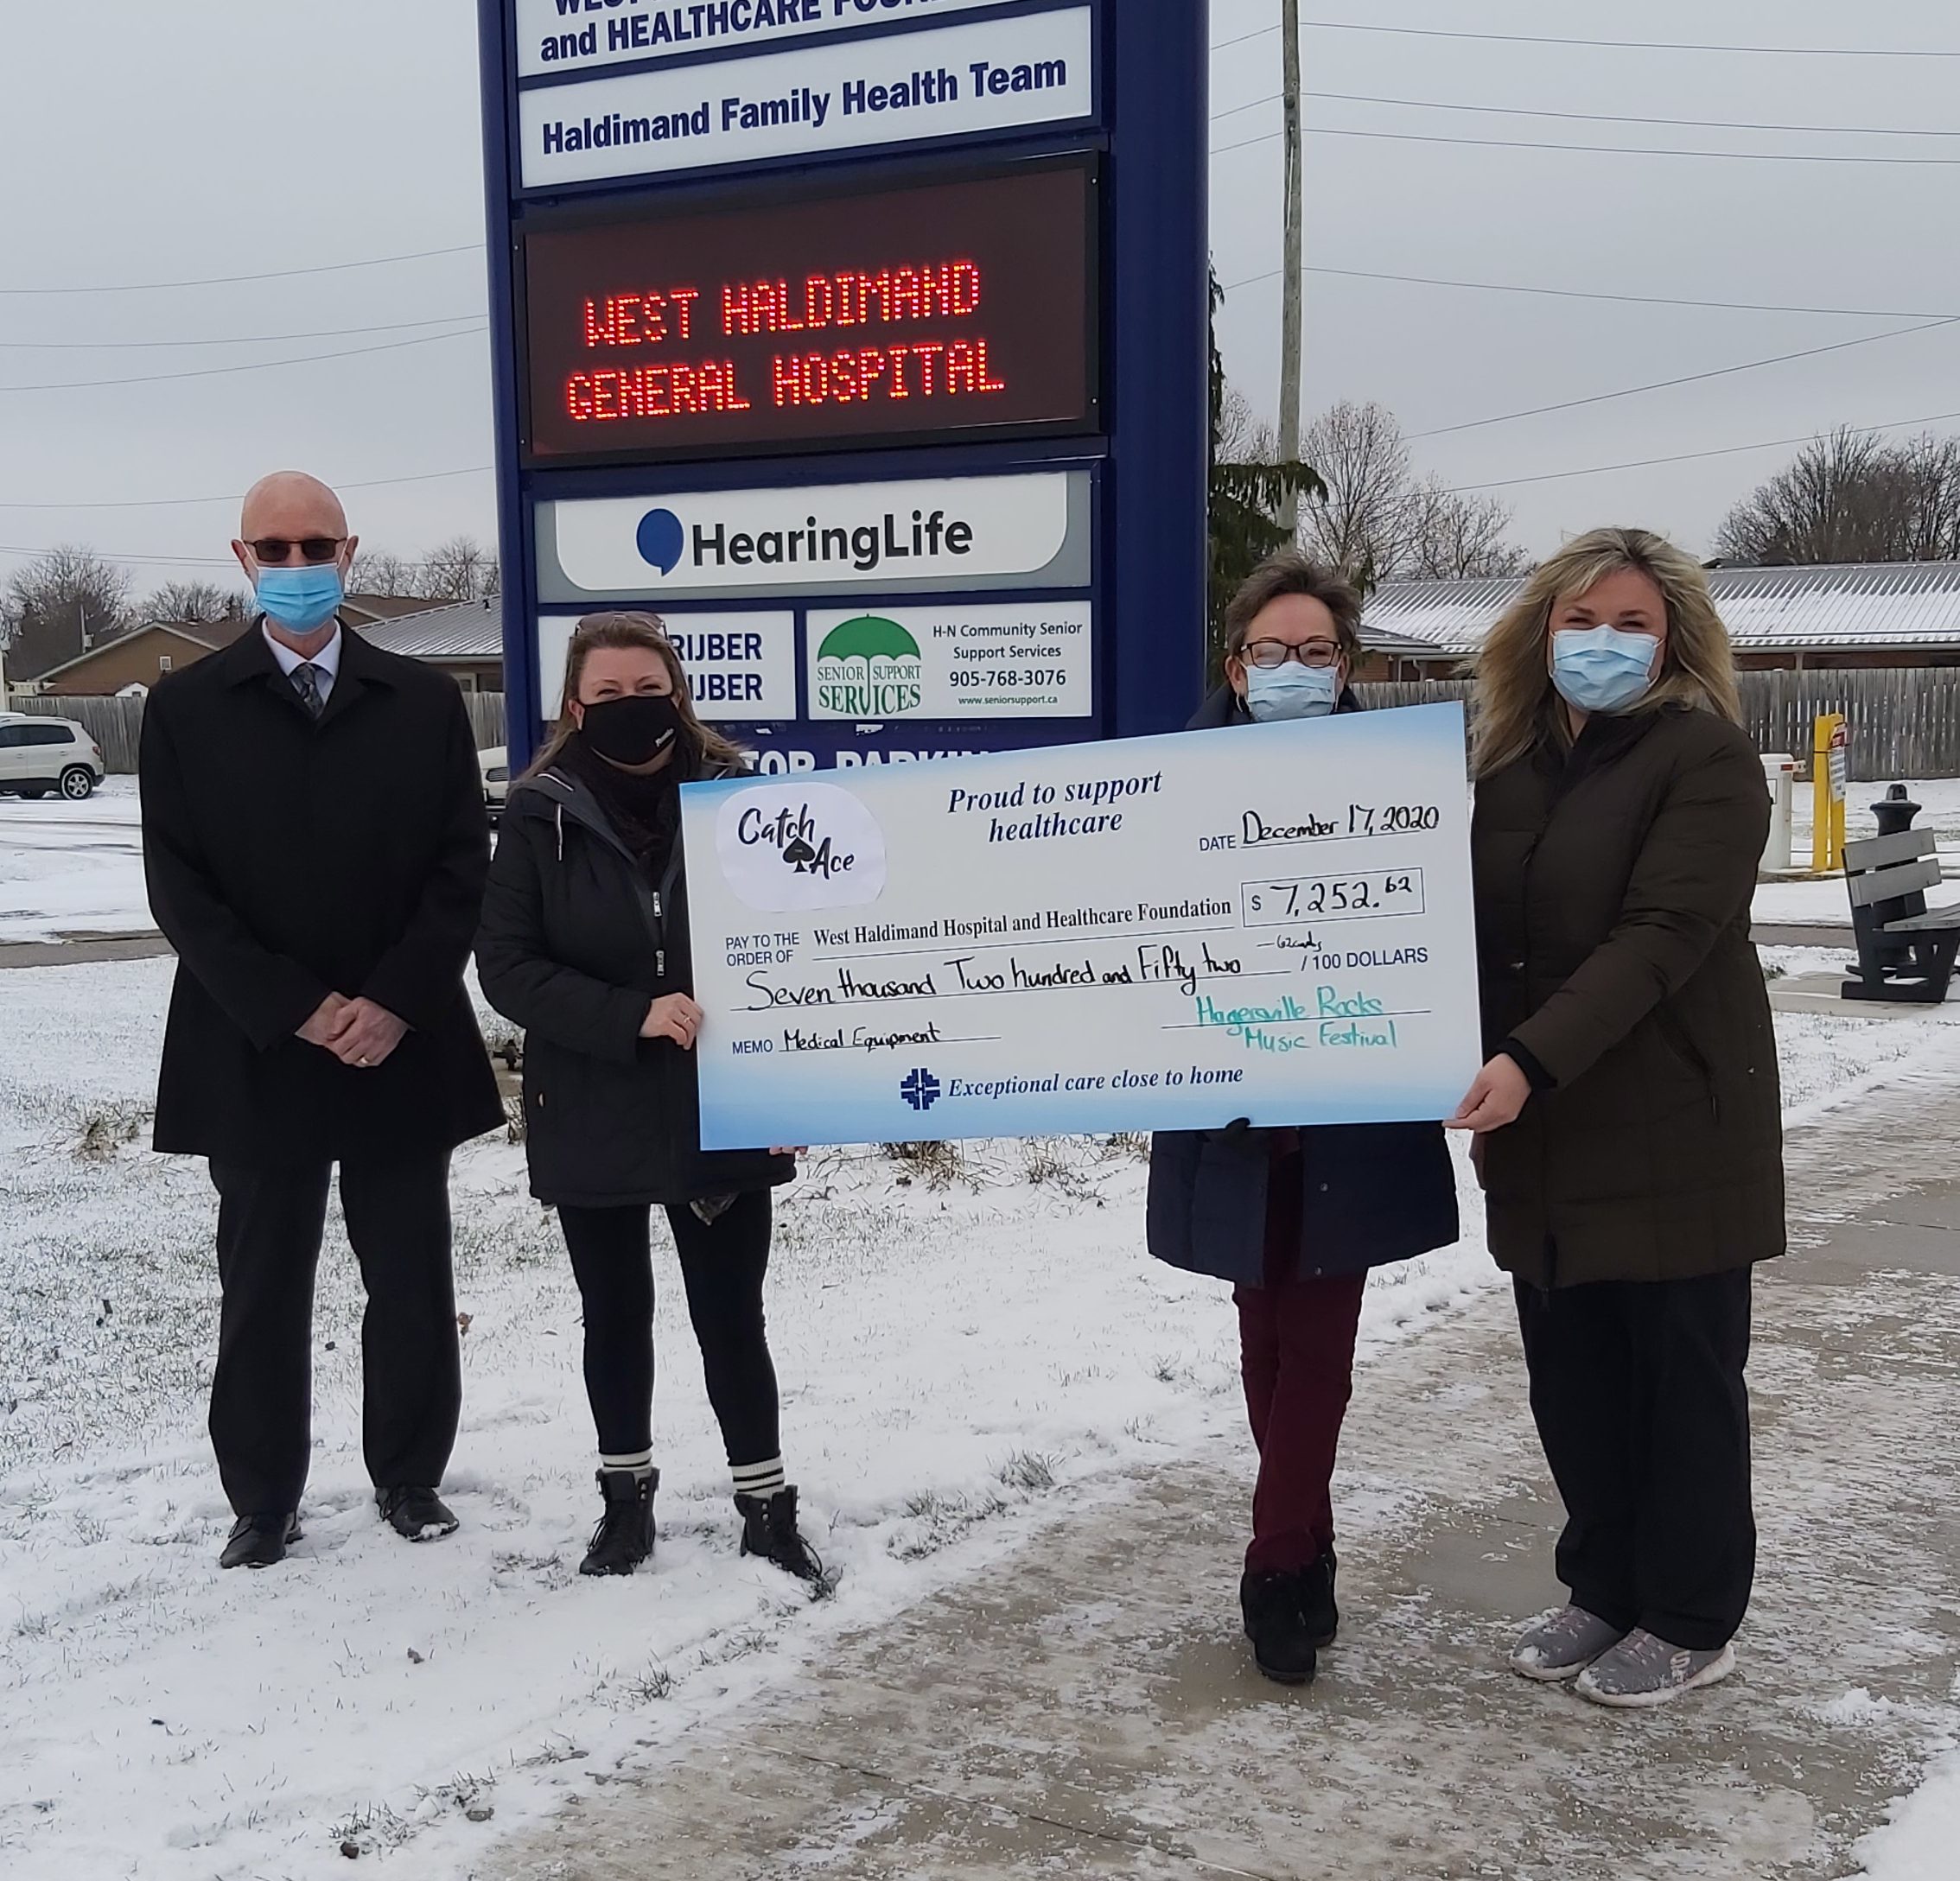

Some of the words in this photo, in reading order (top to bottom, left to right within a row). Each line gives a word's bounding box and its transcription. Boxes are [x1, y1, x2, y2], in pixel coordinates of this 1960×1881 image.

[540, 22, 597, 61] and
[608, 0, 822, 52] HEALTHCARE
[543, 101, 710, 156] Haldimand
[722, 87, 830, 128] Family
[843, 68, 958, 116] Health
[970, 59, 1067, 98] Team
[585, 289, 701, 347] WEST
[722, 261, 980, 335] HALDIMAND
[567, 360, 752, 421] GENERAL
[773, 338, 1006, 407] HOSPITAL
[692, 509, 973, 571] HearingLife
[932, 625, 957, 638] H-N
[960, 622, 1037, 639] Community
[1040, 621, 1083, 635] Senior
[953, 646, 1005, 662] Support
[1009, 645, 1062, 658] Services
[687, 673, 763, 701] IJBER
[817, 666, 865, 682] SENIOR
[872, 664, 922, 680] SUPPORT
[949, 669, 1066, 687] 905-768-3076
[818, 683, 921, 715] SERVICES
[958, 695, 1059, 706] www.seniorsupport.ca
[947, 781, 1026, 814] Proud
[1033, 783, 1055, 805] to
[1064, 770, 1163, 806] support
[738, 803, 815, 848] Catch
[988, 811, 1123, 843] healthcare
[1242, 810, 1340, 845] December
[809, 836, 855, 880] Ace
[1199, 835, 1237, 851] DATE
[814, 928, 850, 947] West
[854, 920, 939, 944] Haldimand
[943, 914, 1008, 939] Hospital
[1012, 912, 1041, 931] and
[1047, 907, 1133, 929] Healthcare
[1137, 898, 1232, 922] Foundation
[726, 935, 749, 950] PAY
[752, 934, 771, 949] TO
[773, 931, 800, 947] THE
[727, 951, 773, 967] ORDER
[776, 950, 794, 963] OF
[1346, 947, 1429, 969] DOLLARS
[746, 969, 836, 1011] Seven
[837, 967, 937, 999] thousand
[944, 955, 1005, 990] Two
[1009, 956, 1096, 988] hundred
[1102, 964, 1133, 985] and
[1137, 944, 1197, 996] Fifty
[1202, 941, 1241, 975] two
[732, 1039, 773, 1055] MEMO
[784, 1028, 843, 1052] Medical
[853, 1021, 941, 1053] Equipment
[1245, 1026, 1311, 1052] Music
[1320, 1020, 1397, 1048] Festival
[949, 1073, 1060, 1100] Exceptional
[1064, 1074, 1105, 1091] care
[1111, 1069, 1159, 1089] close
[1165, 1068, 1183, 1086] to
[1189, 1065, 1244, 1085] home
